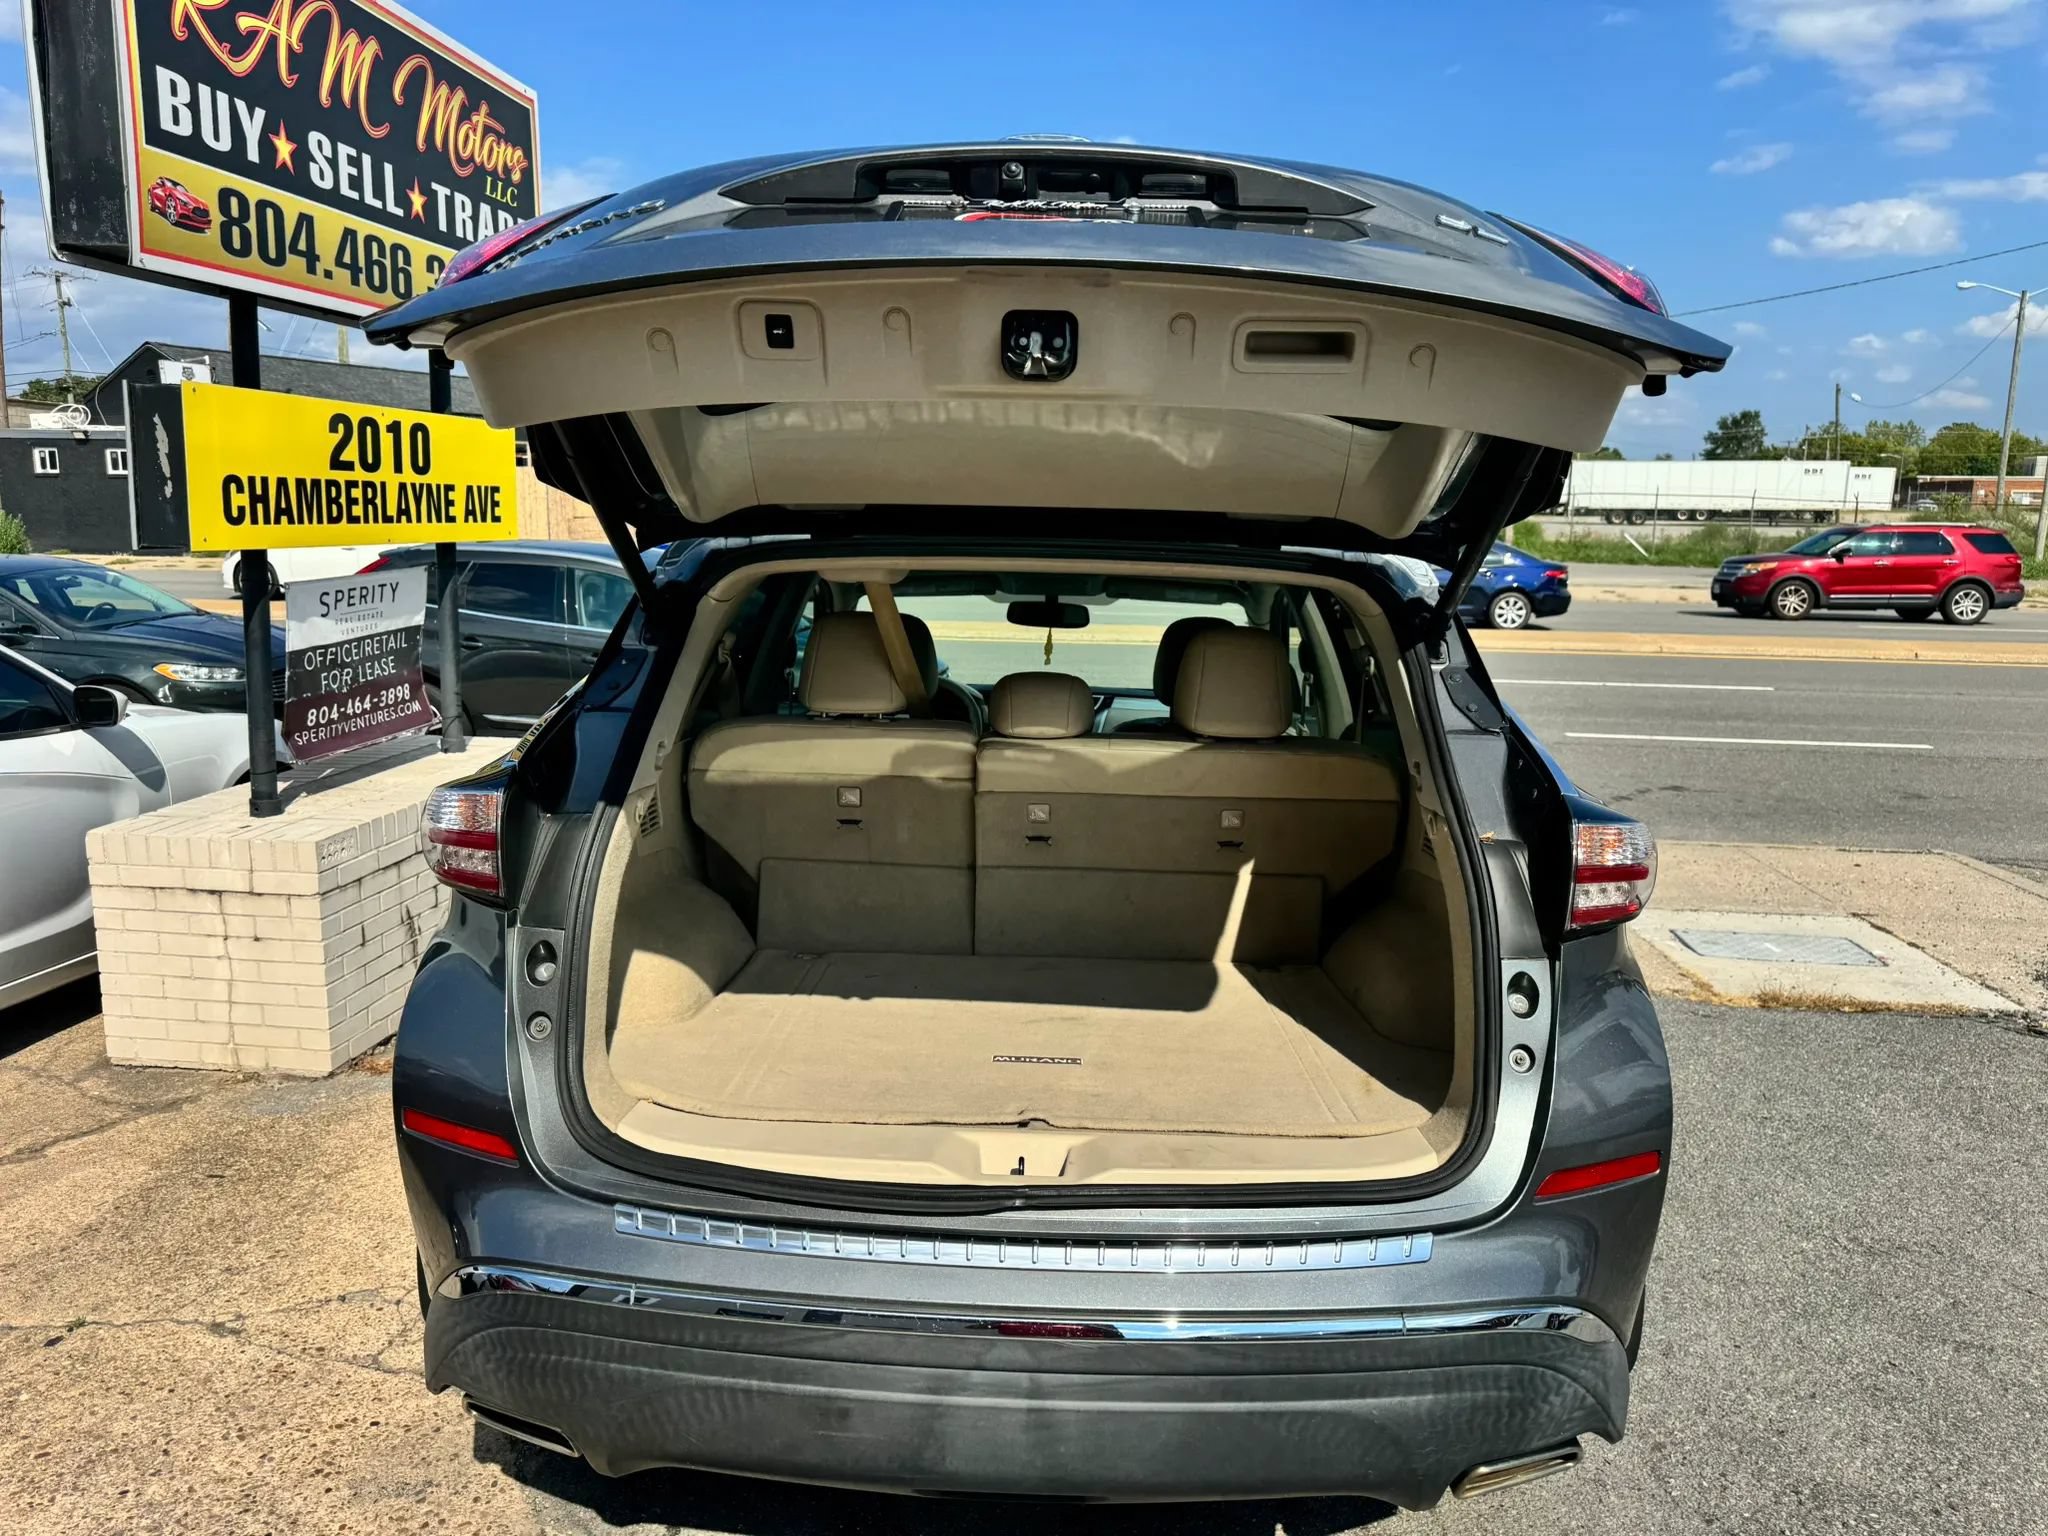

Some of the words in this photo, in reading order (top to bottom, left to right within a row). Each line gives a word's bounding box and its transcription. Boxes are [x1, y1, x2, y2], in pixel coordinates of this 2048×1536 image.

[392, 54, 528, 184] Motors
[156, 64, 266, 164] BUY
[308, 131, 404, 217] SELL
[431, 182, 527, 243] TRA
[485, 175, 518, 207] LLC
[217, 187, 446, 300] 804.4663
[328, 413, 431, 475] 2010
[221, 474, 457, 526] CHAMBERLAYNE
[464, 485, 501, 523] AVE
[319, 582, 399, 618] SPERITY
[304, 631, 408, 671] OFFICE/RETAIL
[341, 622, 378, 636] VENTURES
[321, 668, 353, 694] FOR
[359, 656, 397, 682] LEASE
[294, 700, 422, 746] SPERITYVENTURES.COM
[307, 683, 411, 727] 804-464-3898
[993, 1055, 1082, 1064] MURANO
